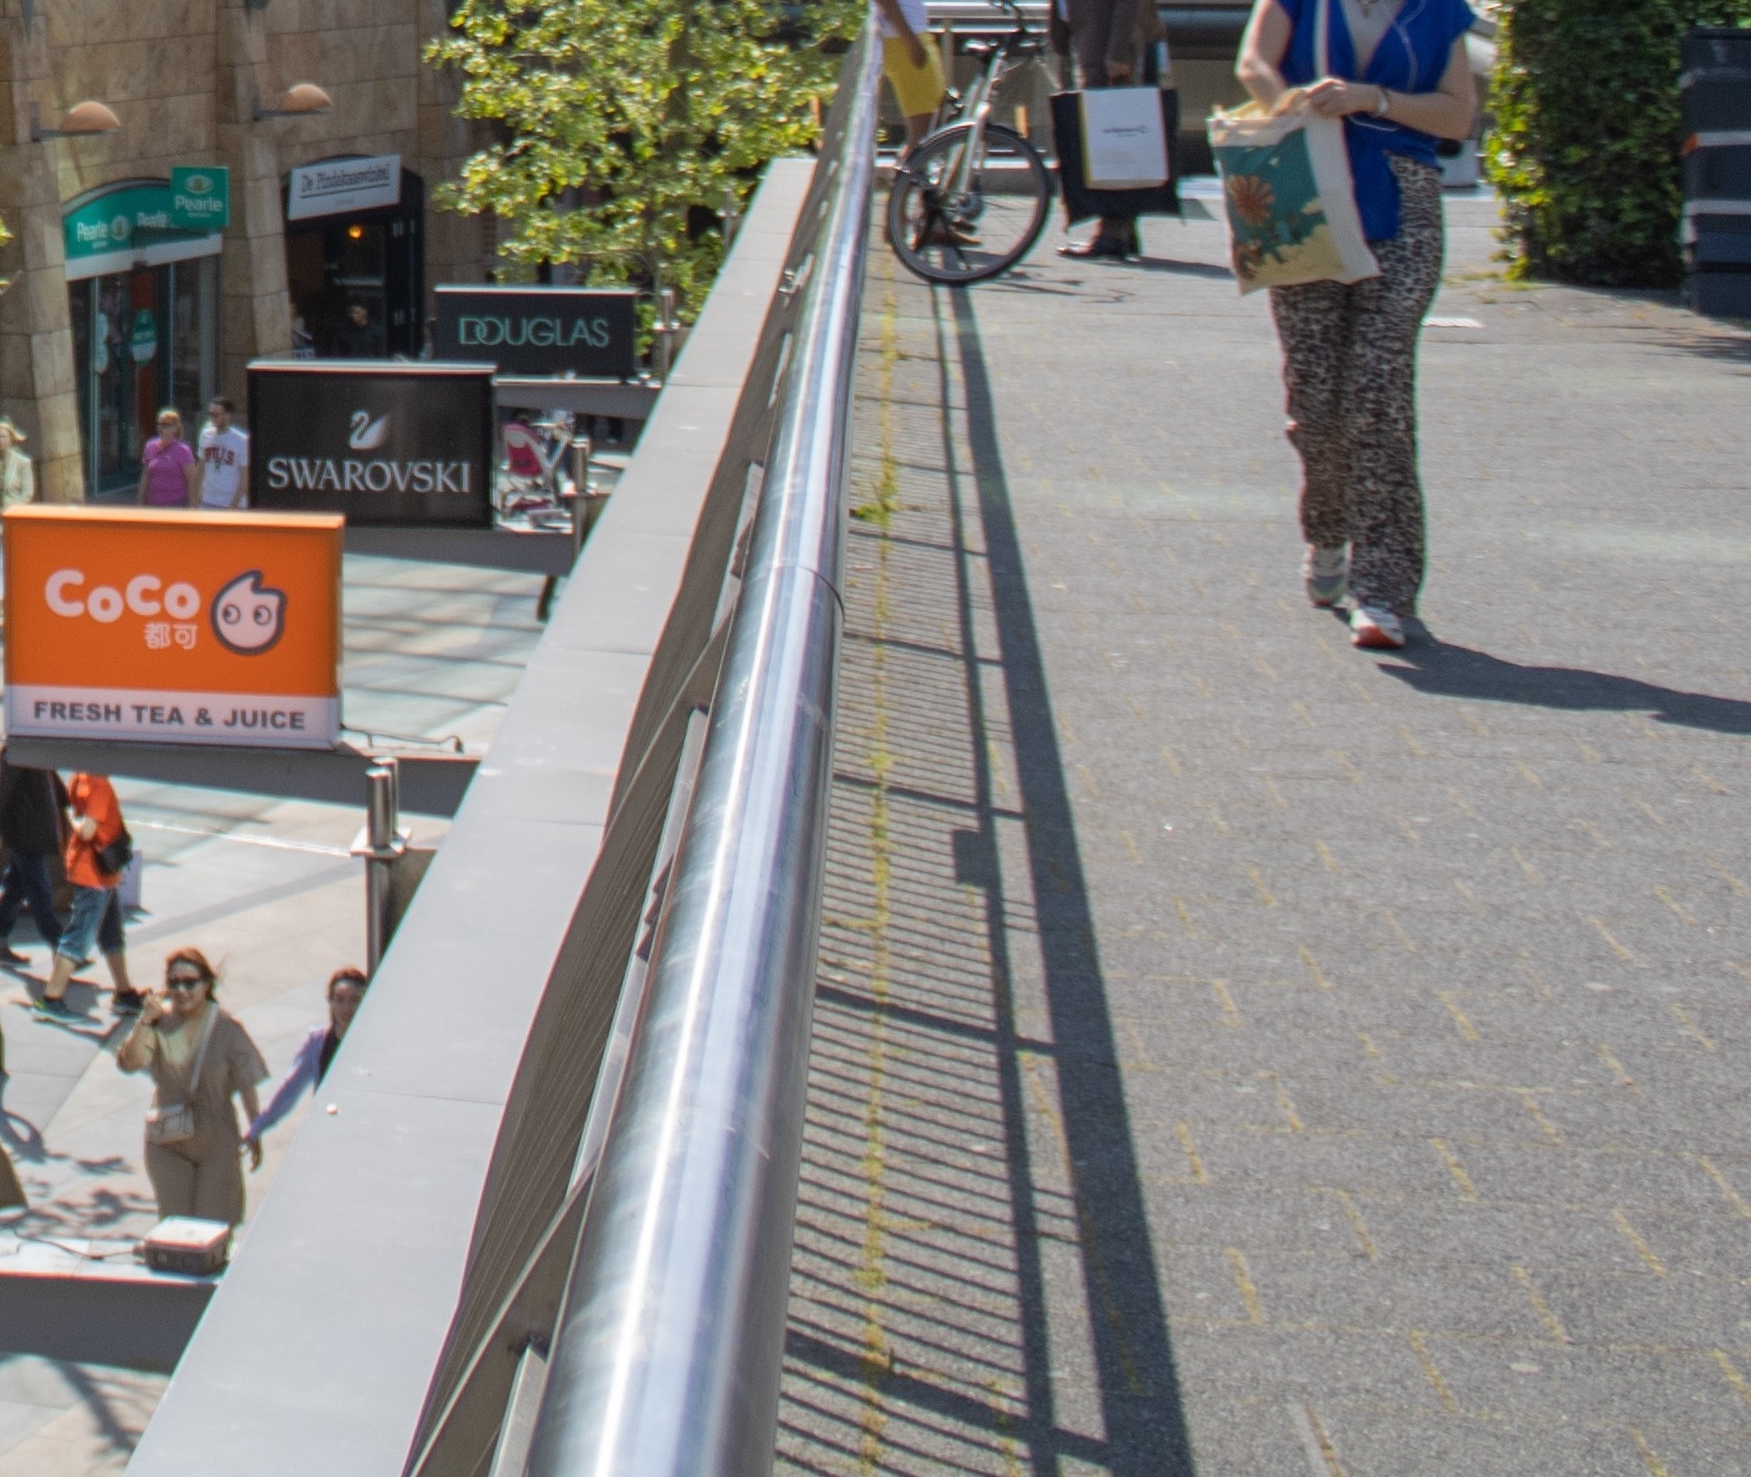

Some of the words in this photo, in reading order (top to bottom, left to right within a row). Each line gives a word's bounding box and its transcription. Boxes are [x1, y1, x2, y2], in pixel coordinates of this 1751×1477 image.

[175, 194, 224, 213] Pearle
[458, 316, 610, 347] DOUGLAS
[267, 457, 472, 493] SWAROVSKI
[144, 622, 199, 650] 都可
[34, 700, 122, 723] FRESH
[130, 704, 185, 726] TEA
[194, 709, 212, 727] &
[223, 709, 306, 730] JUICE
